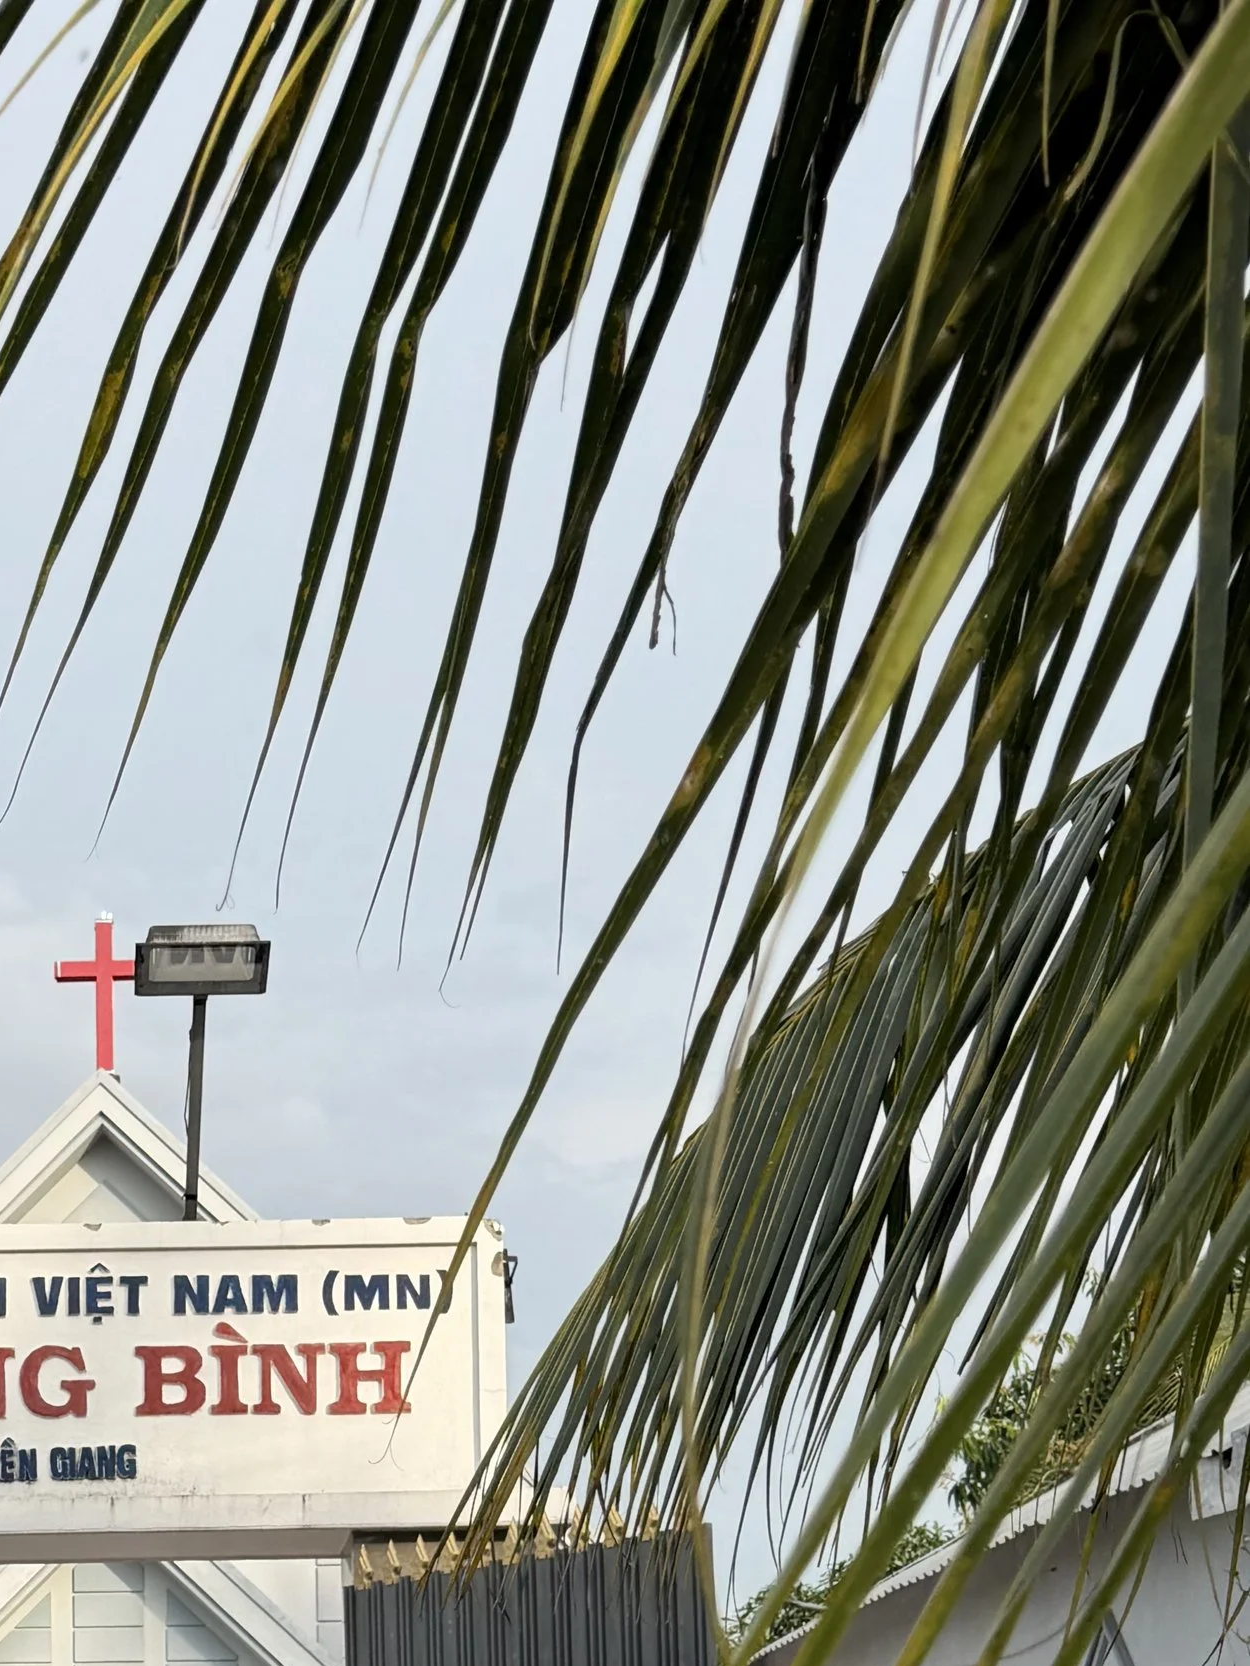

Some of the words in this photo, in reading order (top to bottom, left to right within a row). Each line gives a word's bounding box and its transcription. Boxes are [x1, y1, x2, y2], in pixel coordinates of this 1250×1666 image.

[31, 1263, 149, 1324] VIỆT
[174, 1274, 299, 1315] NAM
[135, 1322, 412, 1416] BÌNH
[49, 1444, 138, 1481] GIANG
